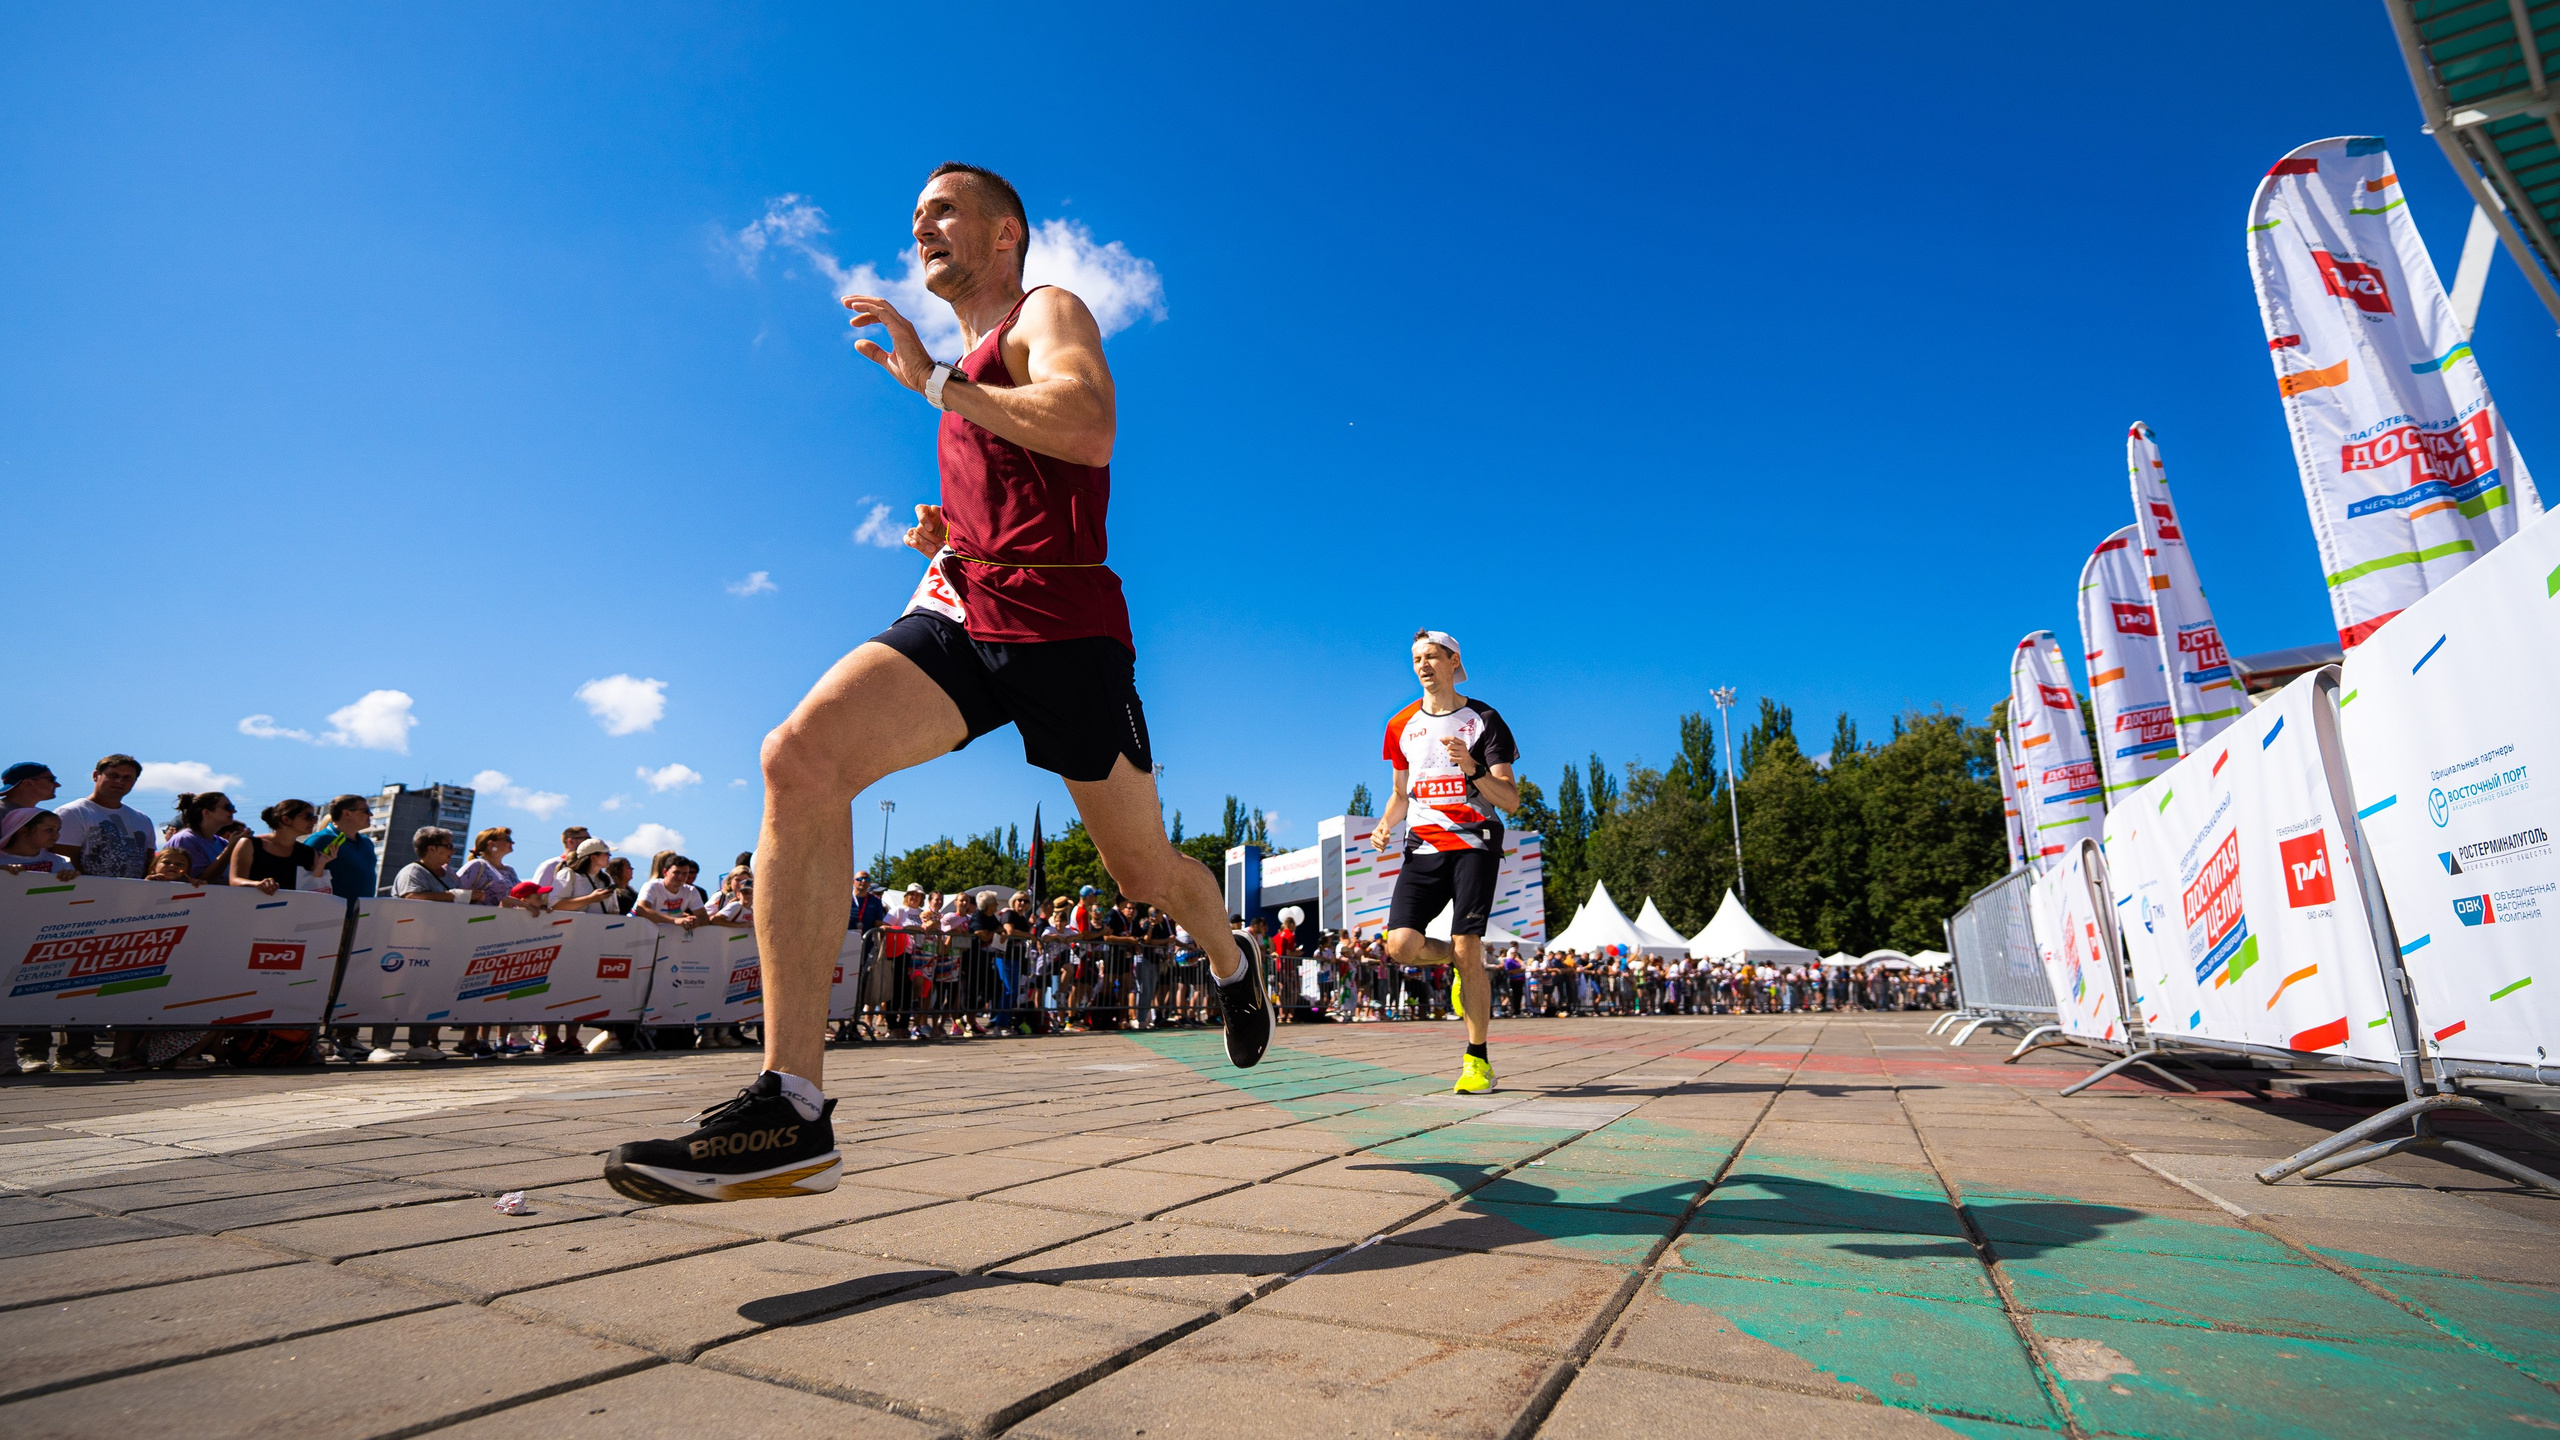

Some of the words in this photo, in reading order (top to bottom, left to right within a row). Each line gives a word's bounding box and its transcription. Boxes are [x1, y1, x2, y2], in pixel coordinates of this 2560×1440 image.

[2442, 398, 2482, 429] ЗАБЕГ
[2430, 757, 2479, 781] Официальные
[2480, 743, 2514, 763] партнеры
[1428, 781, 1464, 795] 2115
[2448, 773, 2501, 803] ВОСТОЧНЫЙ
[2502, 766, 2527, 785] ПОРТ
[2452, 793, 2495, 811] АКЦИОНЕРНОЕ
[2496, 782, 2530, 798] ОБЩЕСТВО
[2458, 827, 2548, 860] РОСТЕРМИНАЛУГОЛЬ
[2517, 848, 2552, 861] ОБЩЕСТВО
[2186, 836, 2238, 925] ДОСТИГАЯ
[2494, 882, 2556, 901] ОБЪЕДИНЕННАЯ
[2206, 873, 2243, 939] ЦЕЛИ!
[2457, 899, 2482, 914] ОВК
[2496, 898, 2536, 912] ВАГОННАЯ
[2499, 909, 2542, 923] КОМПАНИЯ
[35, 928, 97, 941] ПРАЗДНИК
[40, 909, 191, 933] СПОРТИВНО-МУЗЫКАЛЬНЫЙ
[31, 928, 178, 962] ДОСТИГАЯ
[77, 946, 168, 973] ЦЕЛИ!
[470, 947, 555, 975] ДОСТИГАЯ
[496, 960, 549, 983] ЦЕЛИ!
[15, 969, 62, 982] СЕМЬИ
[689, 1125, 800, 1160] BROOKS
